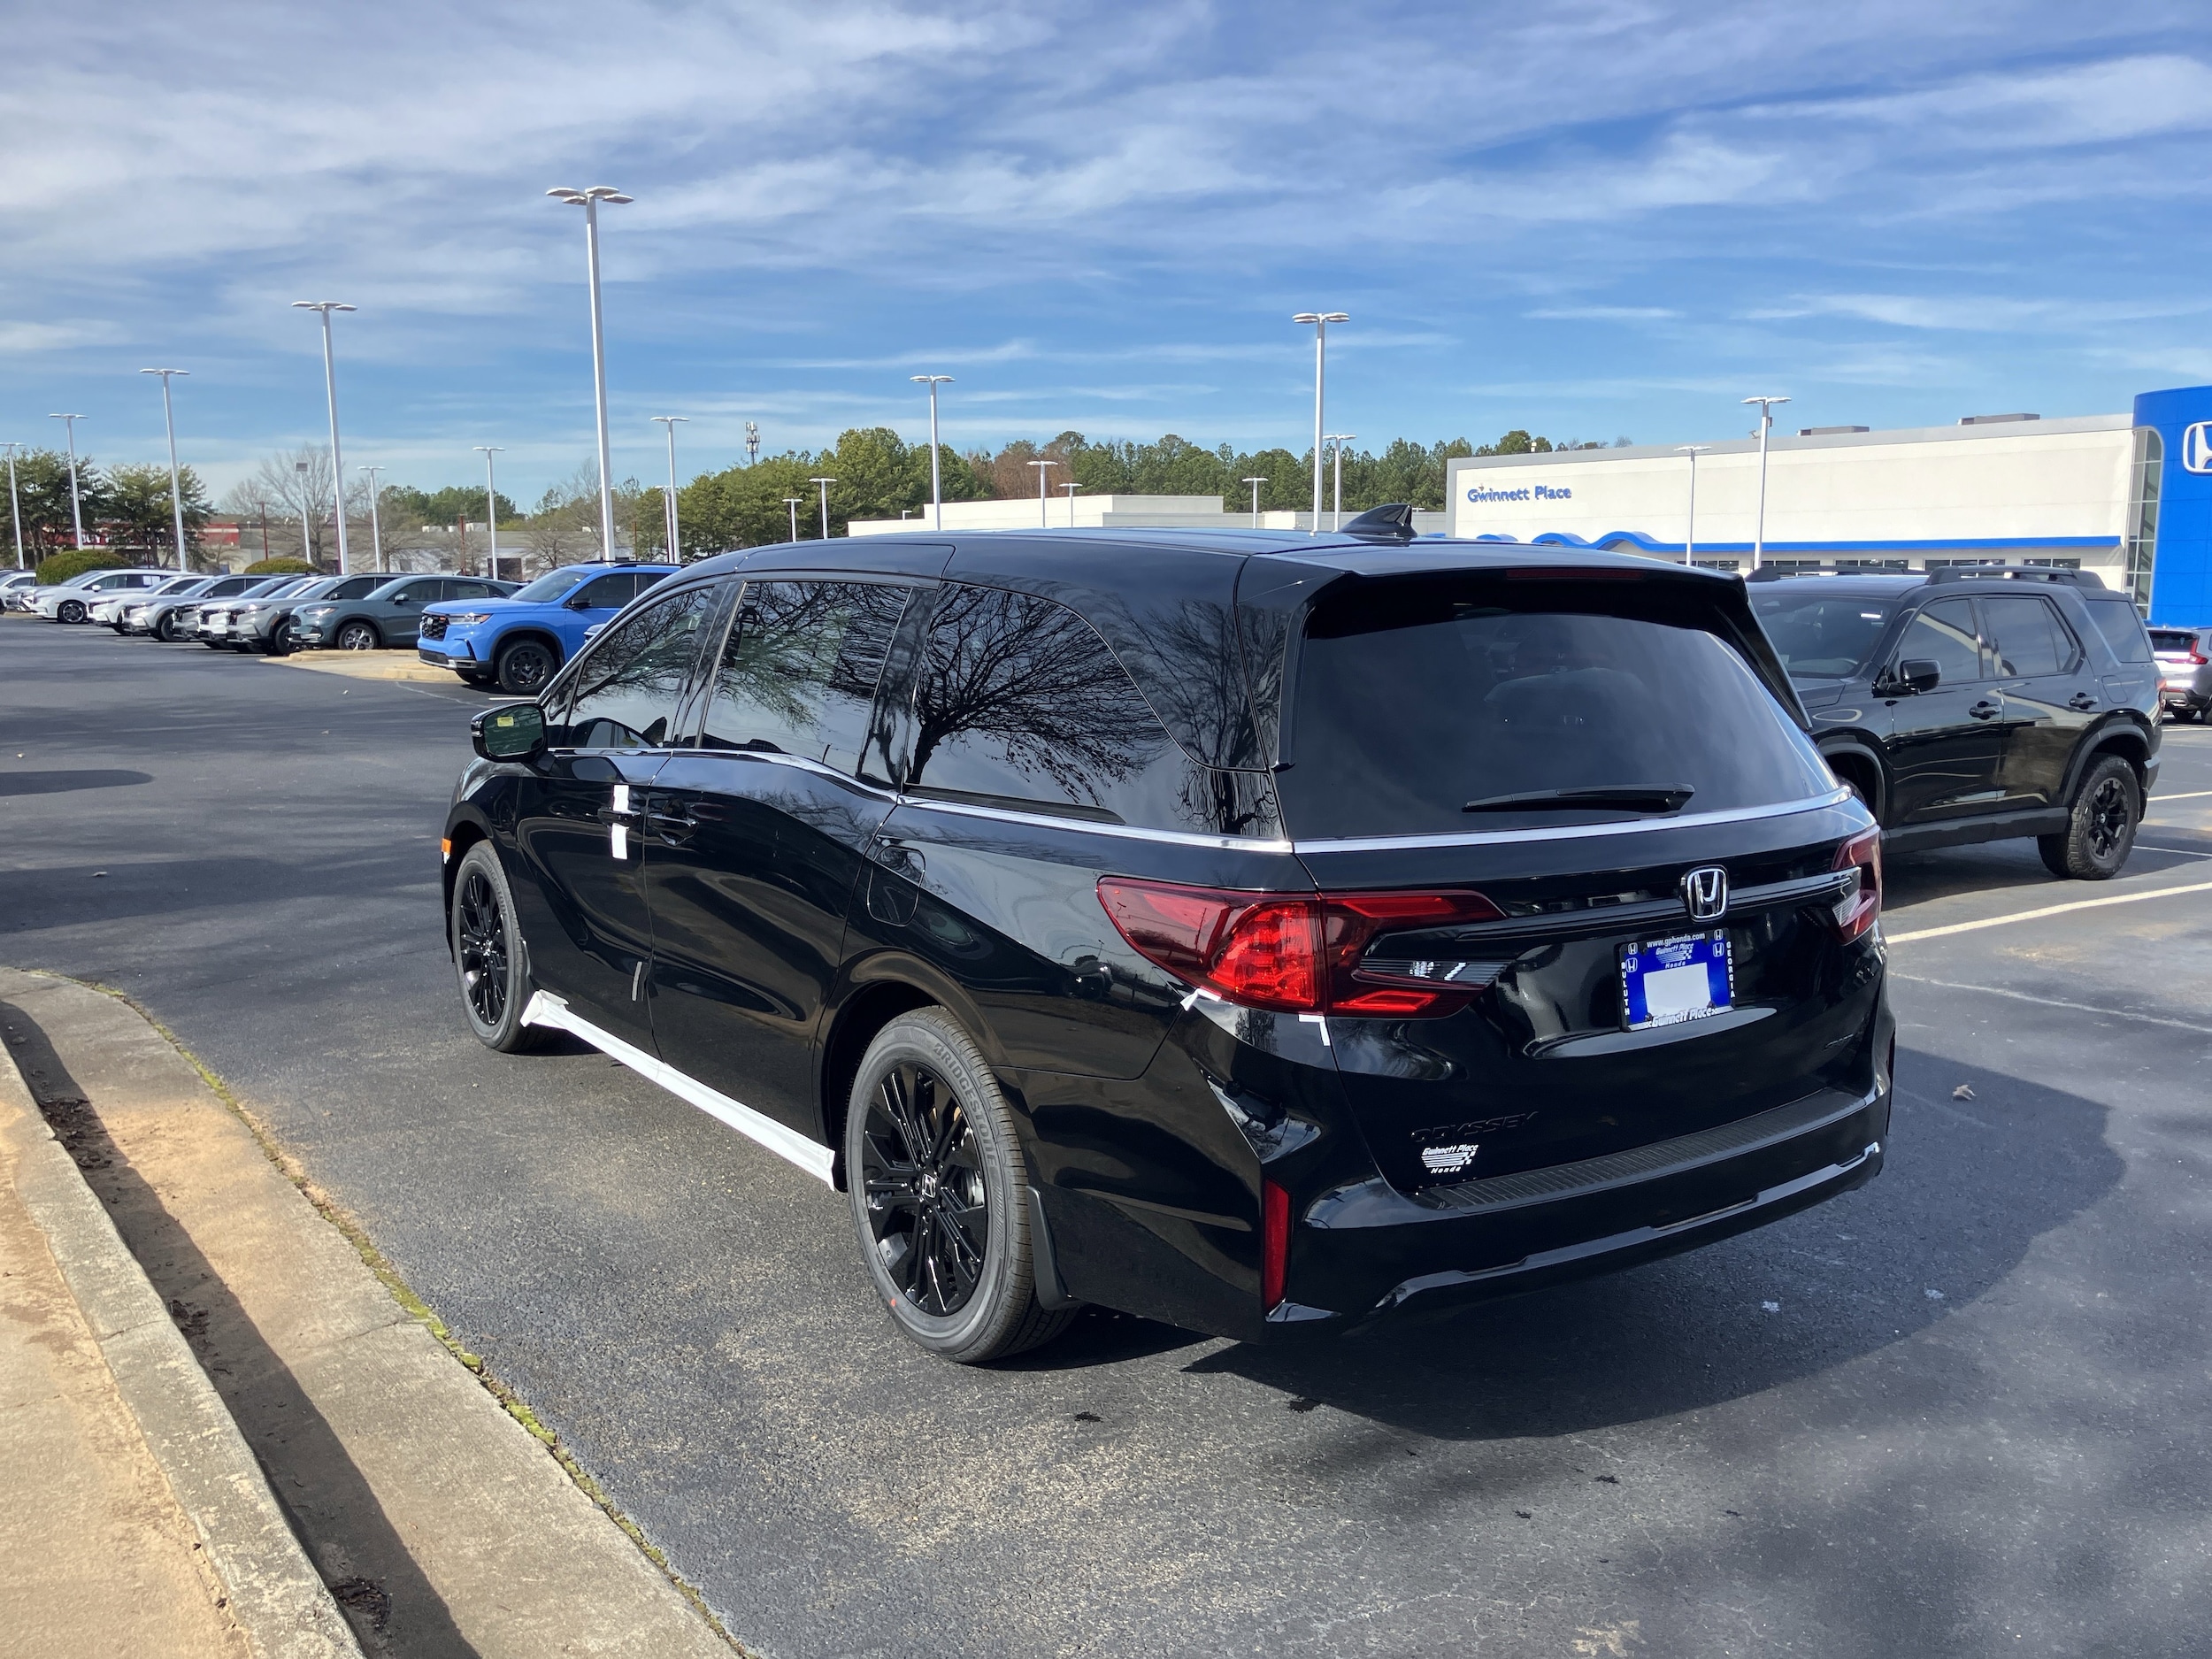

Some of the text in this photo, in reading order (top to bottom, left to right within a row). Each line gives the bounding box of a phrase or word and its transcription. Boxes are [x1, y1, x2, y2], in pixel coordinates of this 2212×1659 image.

[1467, 485, 1572, 503] Gwinnett Place
[1647, 933, 1706, 948] www.gphonda.com
[1621, 962, 1631, 1015] DULUTH
[1726, 941, 1736, 998] GEORGIA
[933, 1042, 997, 1167] BRIDGESTONE
